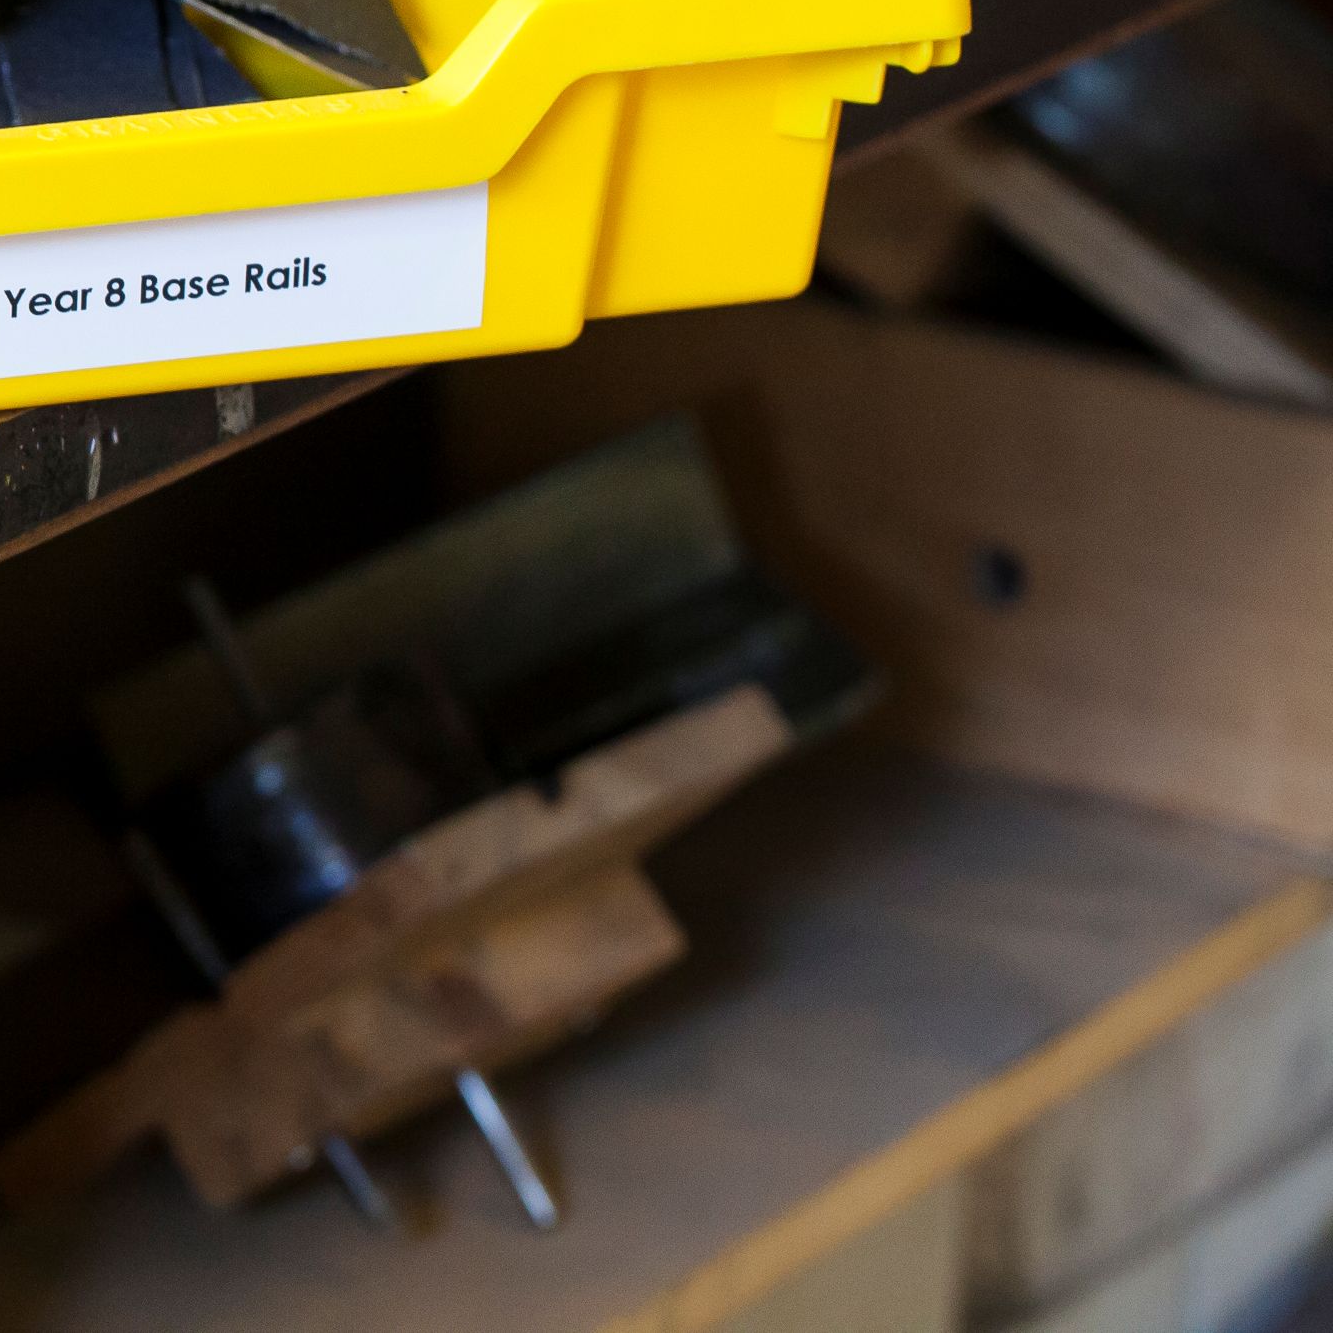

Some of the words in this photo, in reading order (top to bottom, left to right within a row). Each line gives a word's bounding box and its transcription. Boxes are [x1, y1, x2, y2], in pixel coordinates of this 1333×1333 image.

[3, 286, 94, 319] Year
[103, 276, 127, 309] 8
[139, 272, 231, 305] Base
[243, 256, 328, 293] Rails
